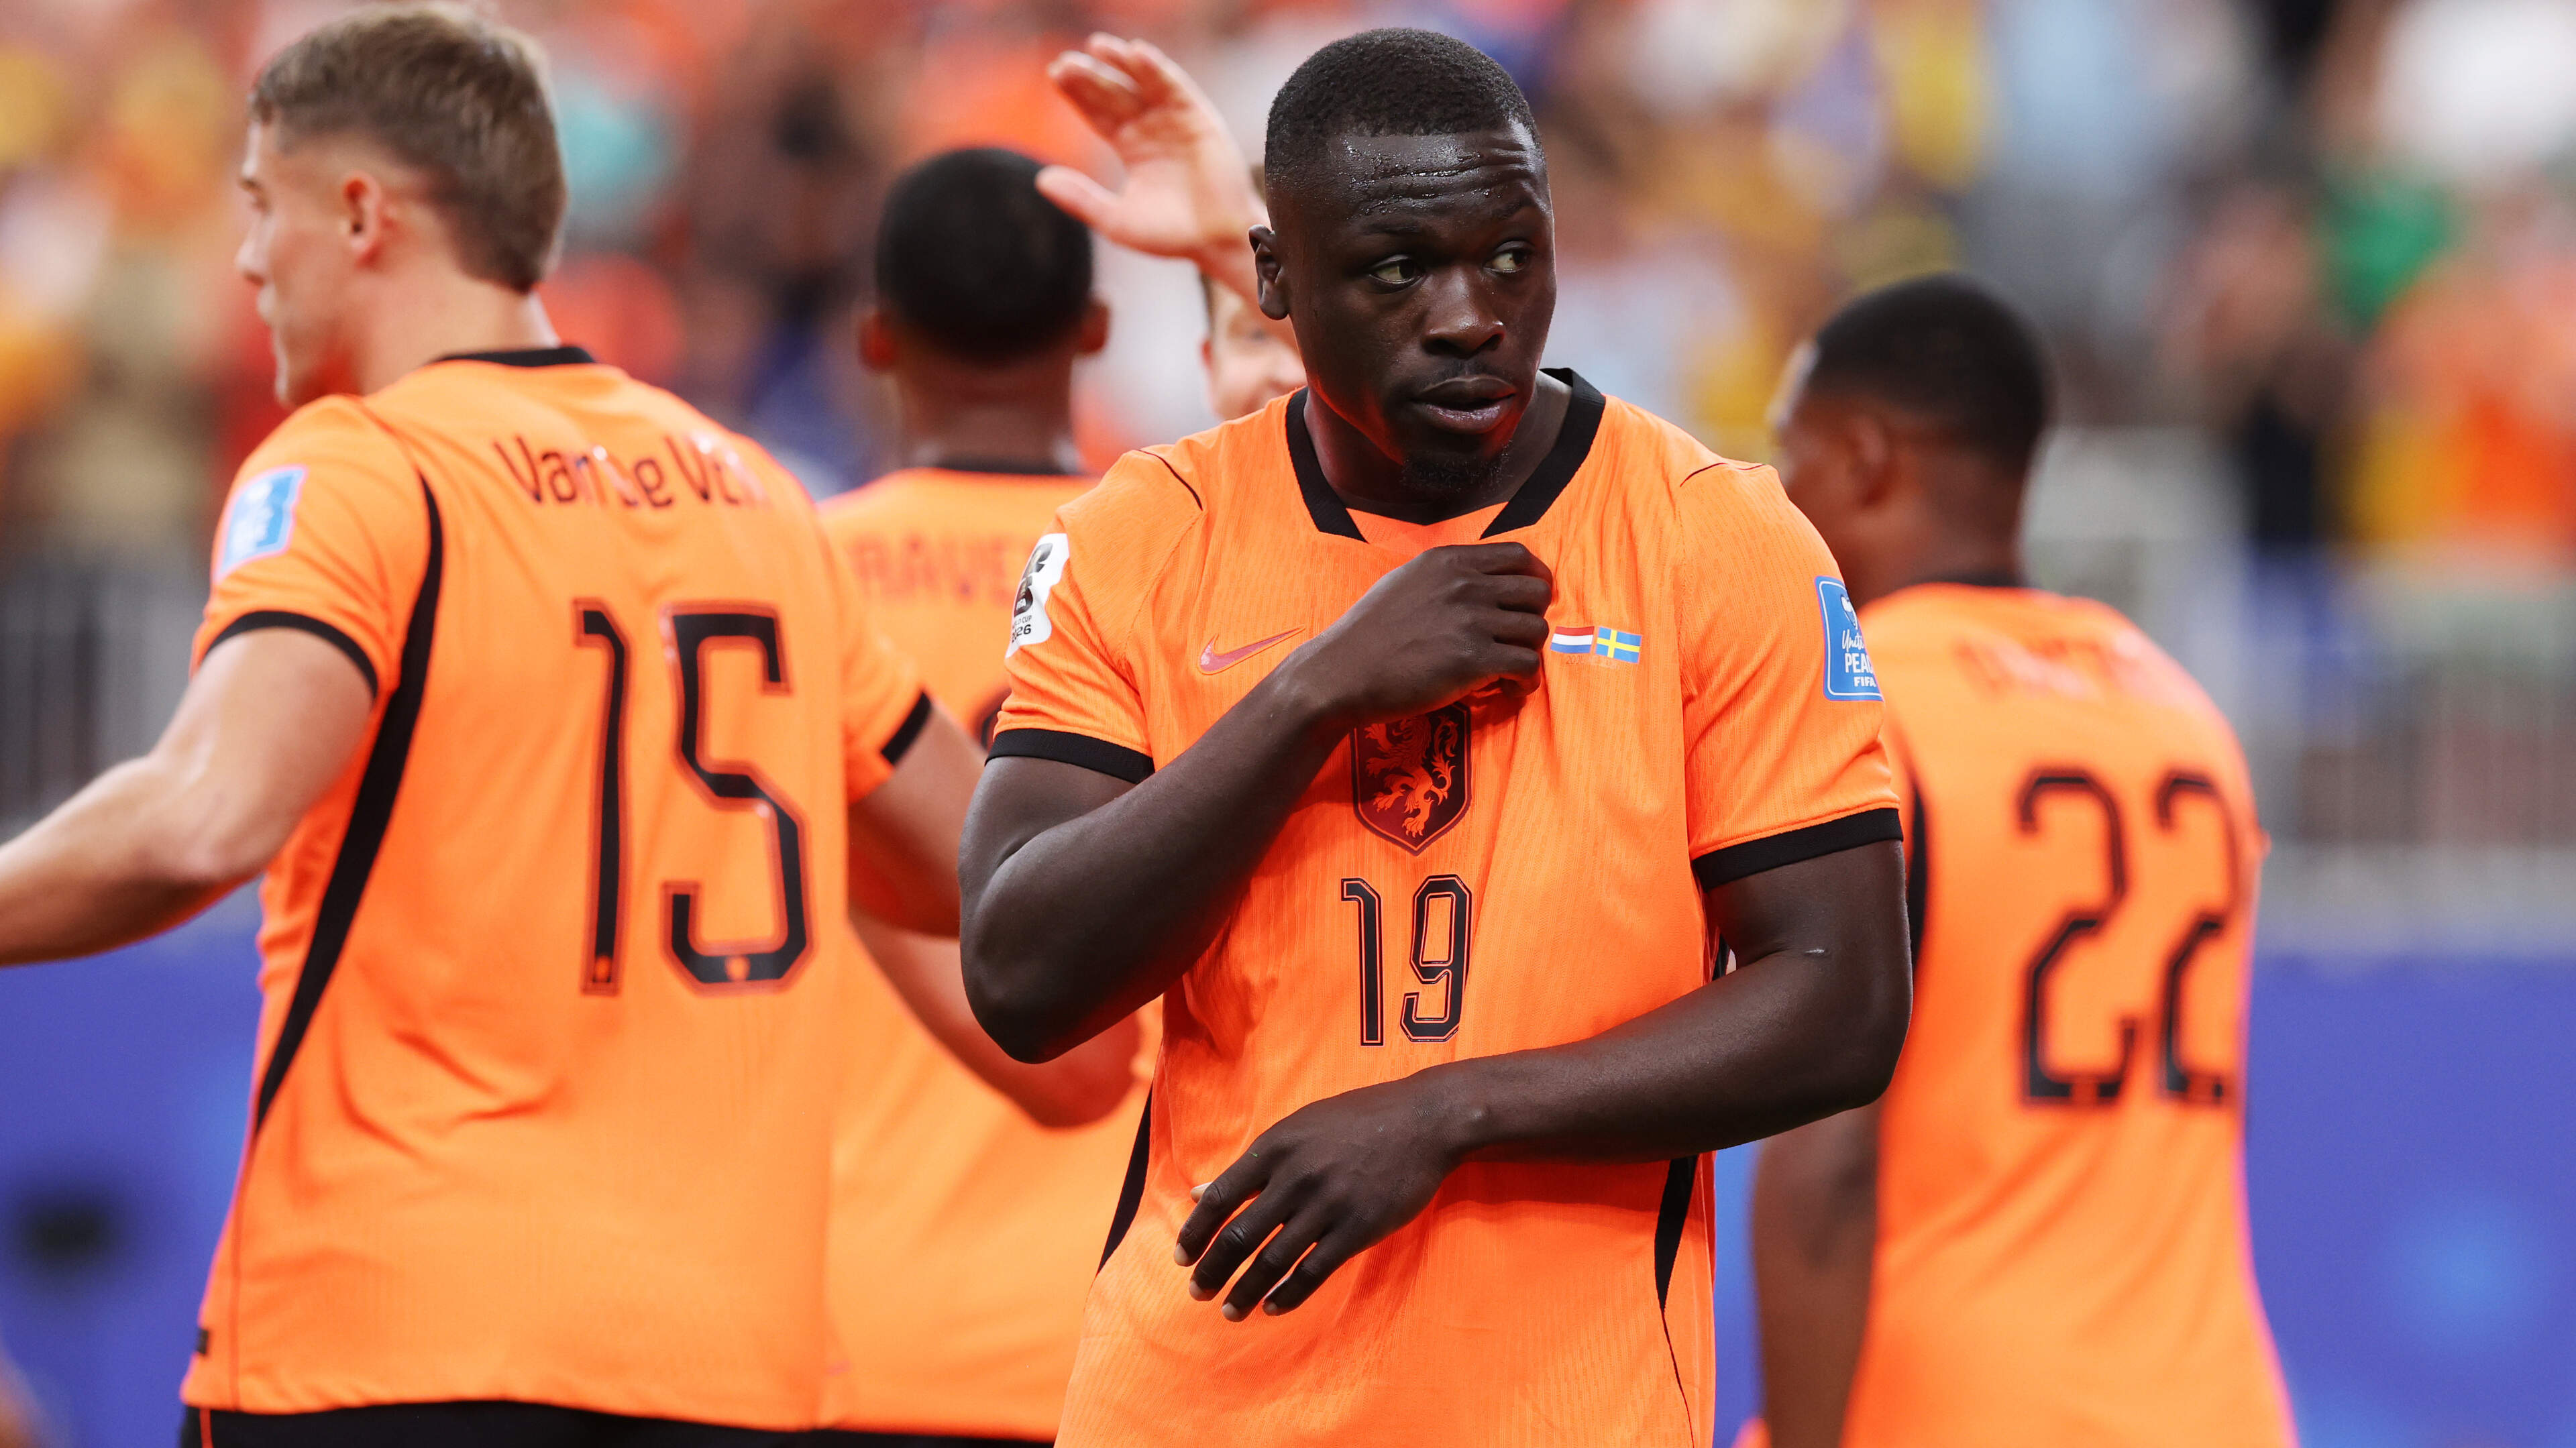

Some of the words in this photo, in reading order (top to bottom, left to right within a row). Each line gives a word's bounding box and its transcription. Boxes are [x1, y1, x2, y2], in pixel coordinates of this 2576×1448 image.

[492, 433, 607, 506] Van
[1854, 676, 1877, 687] FIFA
[572, 597, 818, 997] 15
[1342, 874, 1472, 1046] 19
[2017, 768, 2243, 1104] 22
